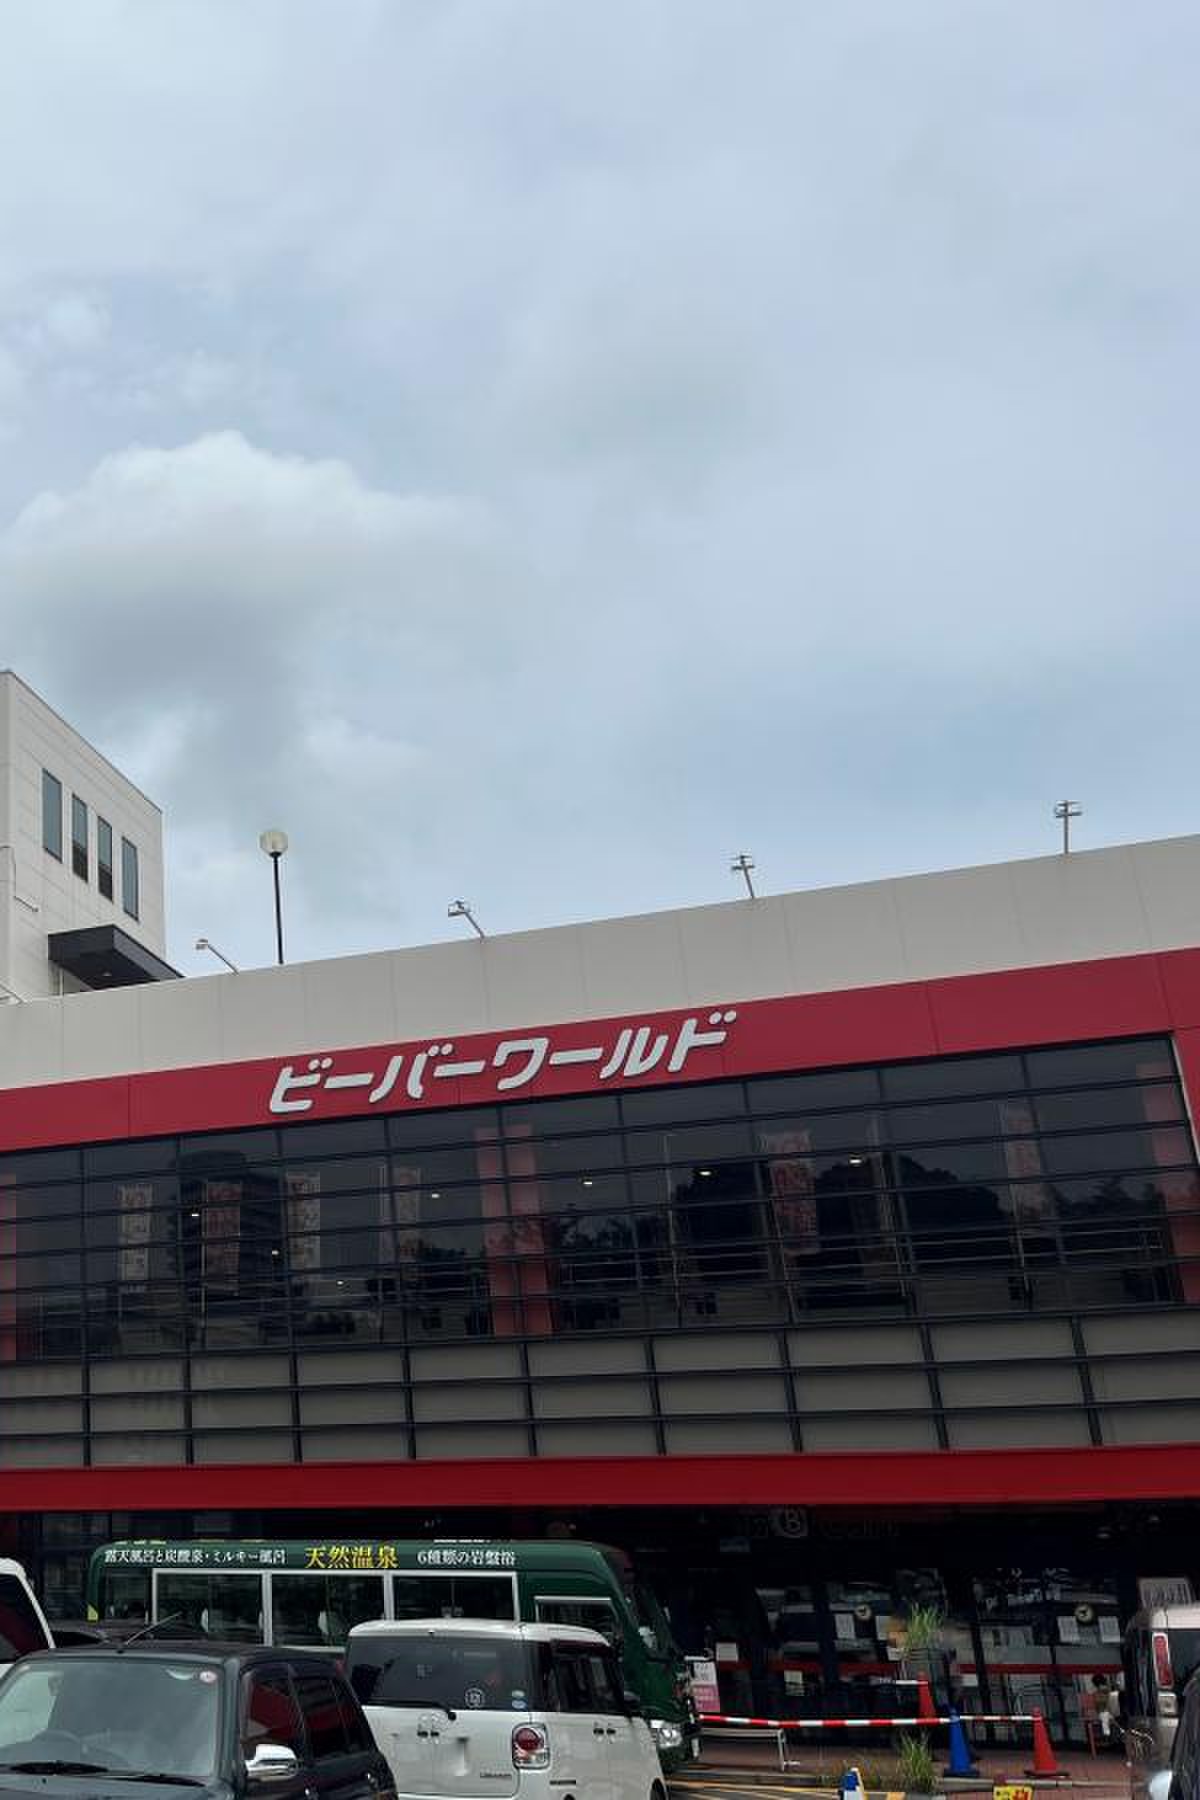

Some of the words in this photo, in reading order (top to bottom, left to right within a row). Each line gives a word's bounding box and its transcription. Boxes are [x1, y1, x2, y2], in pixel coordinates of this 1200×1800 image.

[269, 1010, 737, 1114] ビーバーワールド
[304, 1545, 399, 1570] 天然温泉
